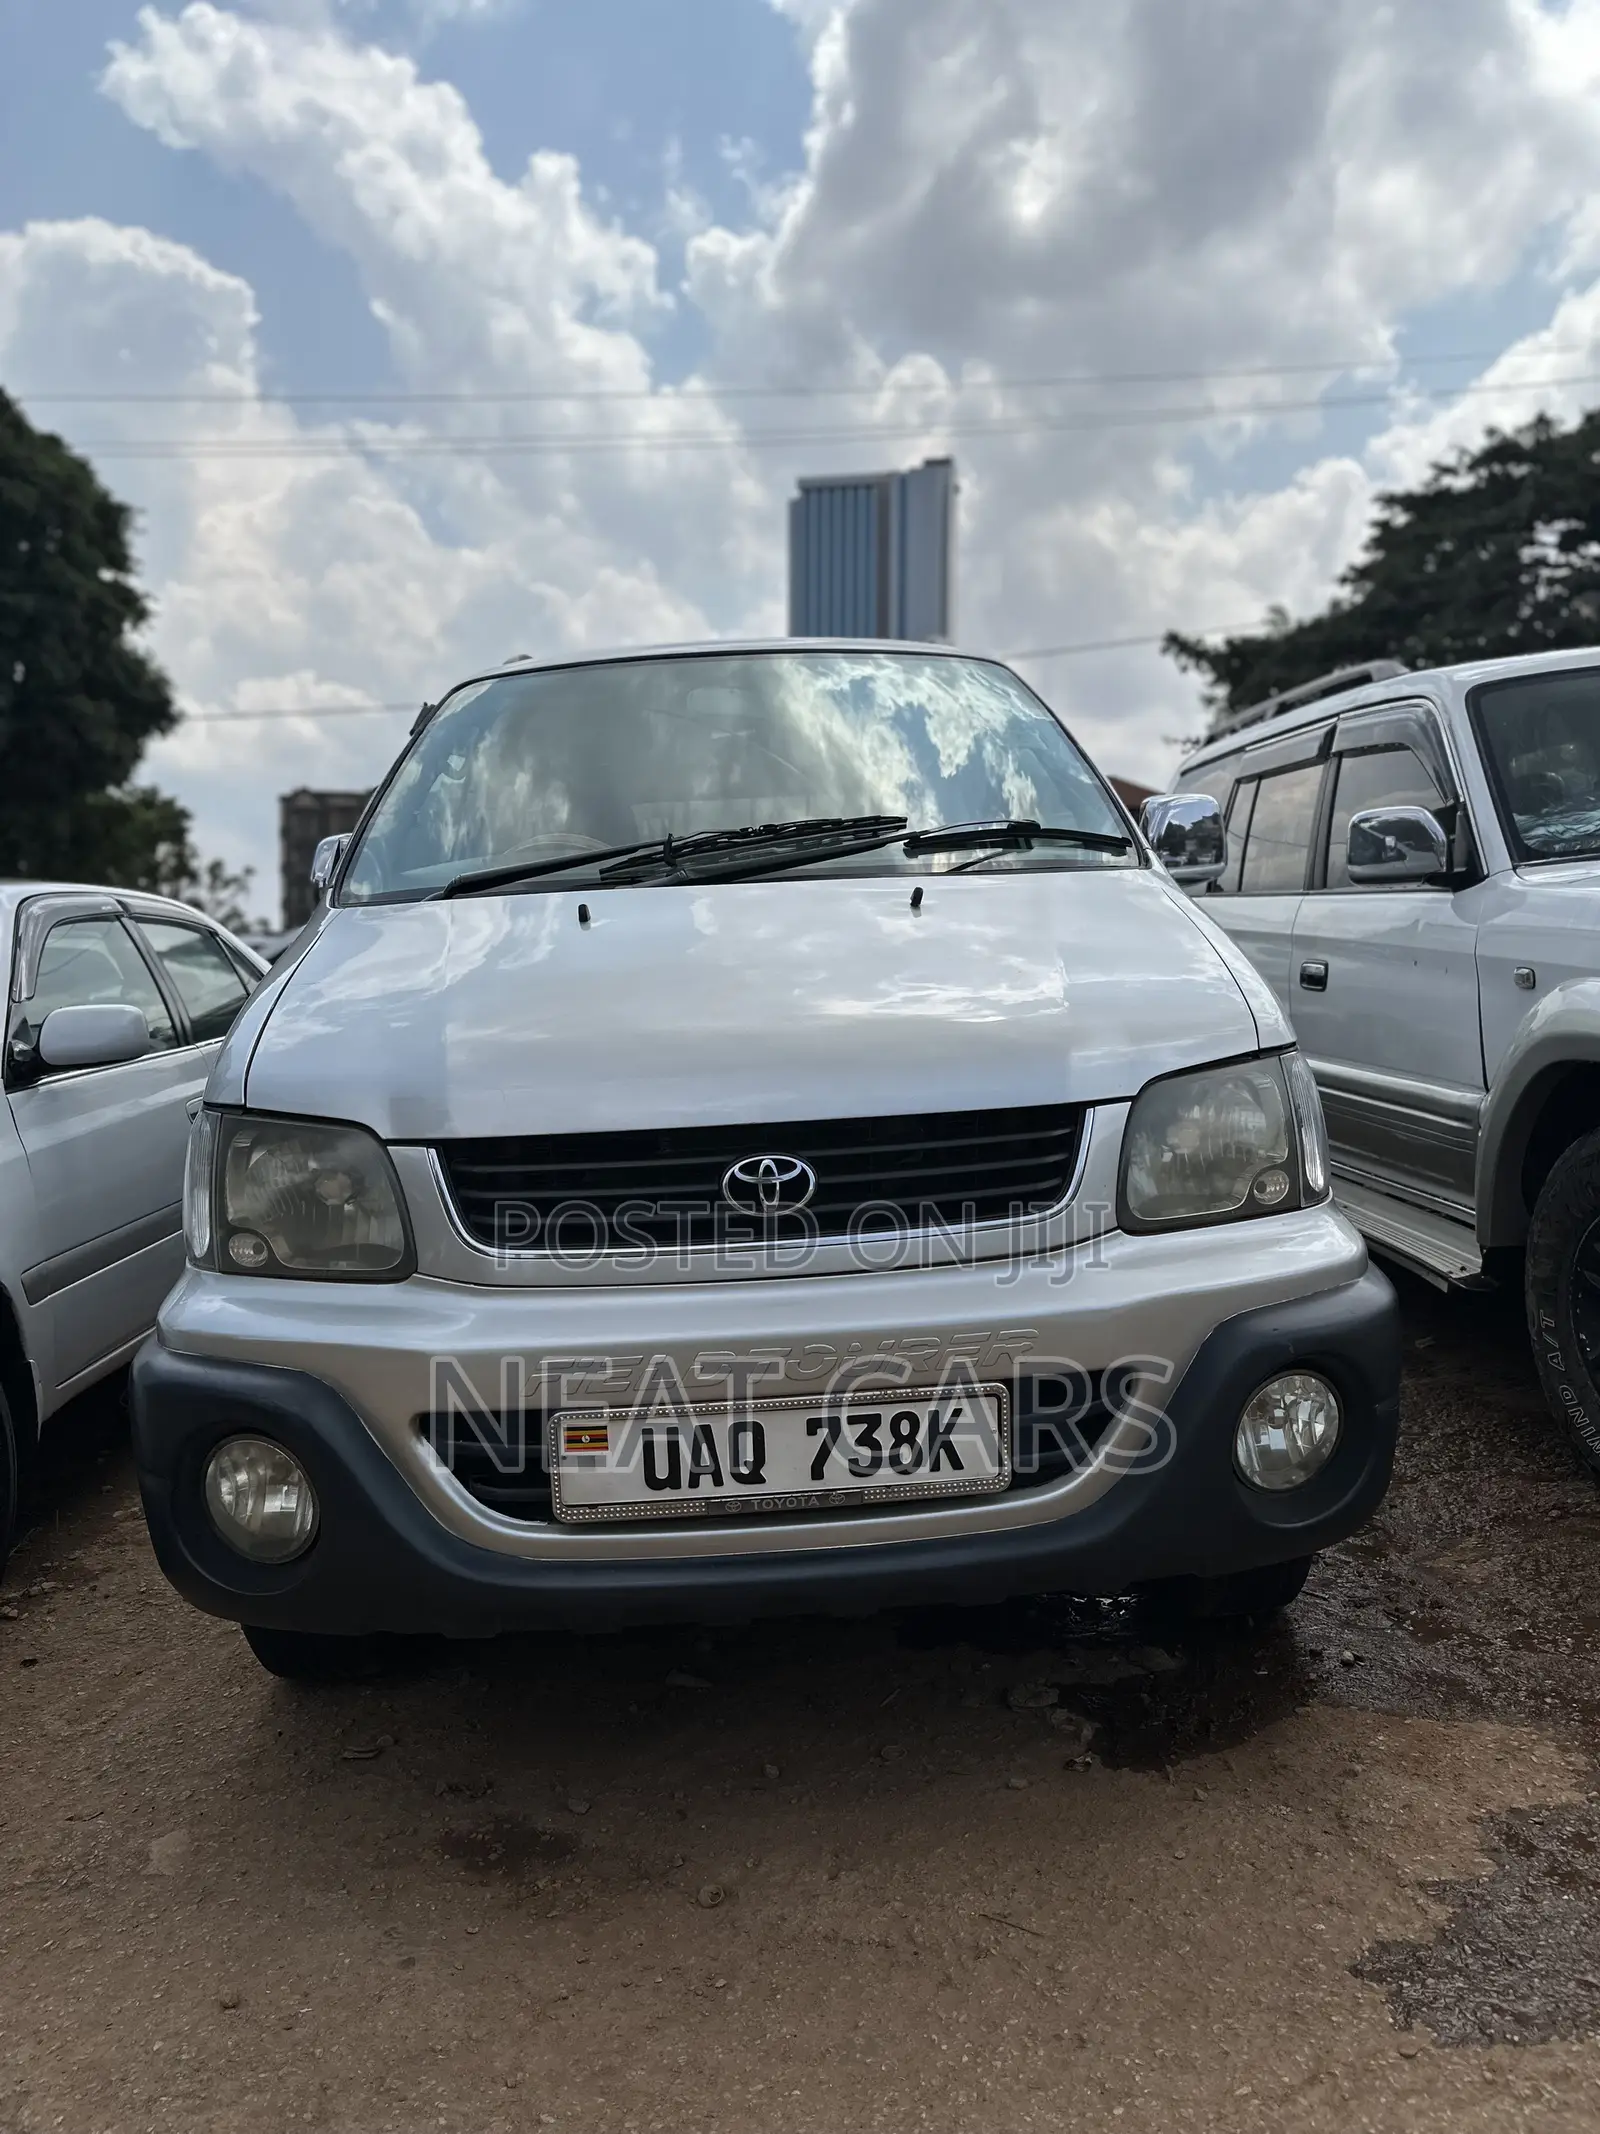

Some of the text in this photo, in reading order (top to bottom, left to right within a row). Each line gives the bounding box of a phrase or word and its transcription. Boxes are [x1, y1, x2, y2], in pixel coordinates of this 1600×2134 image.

[641, 1407, 965, 1491] UAQ 738K
[750, 1496, 821, 1511] TOYOTA
